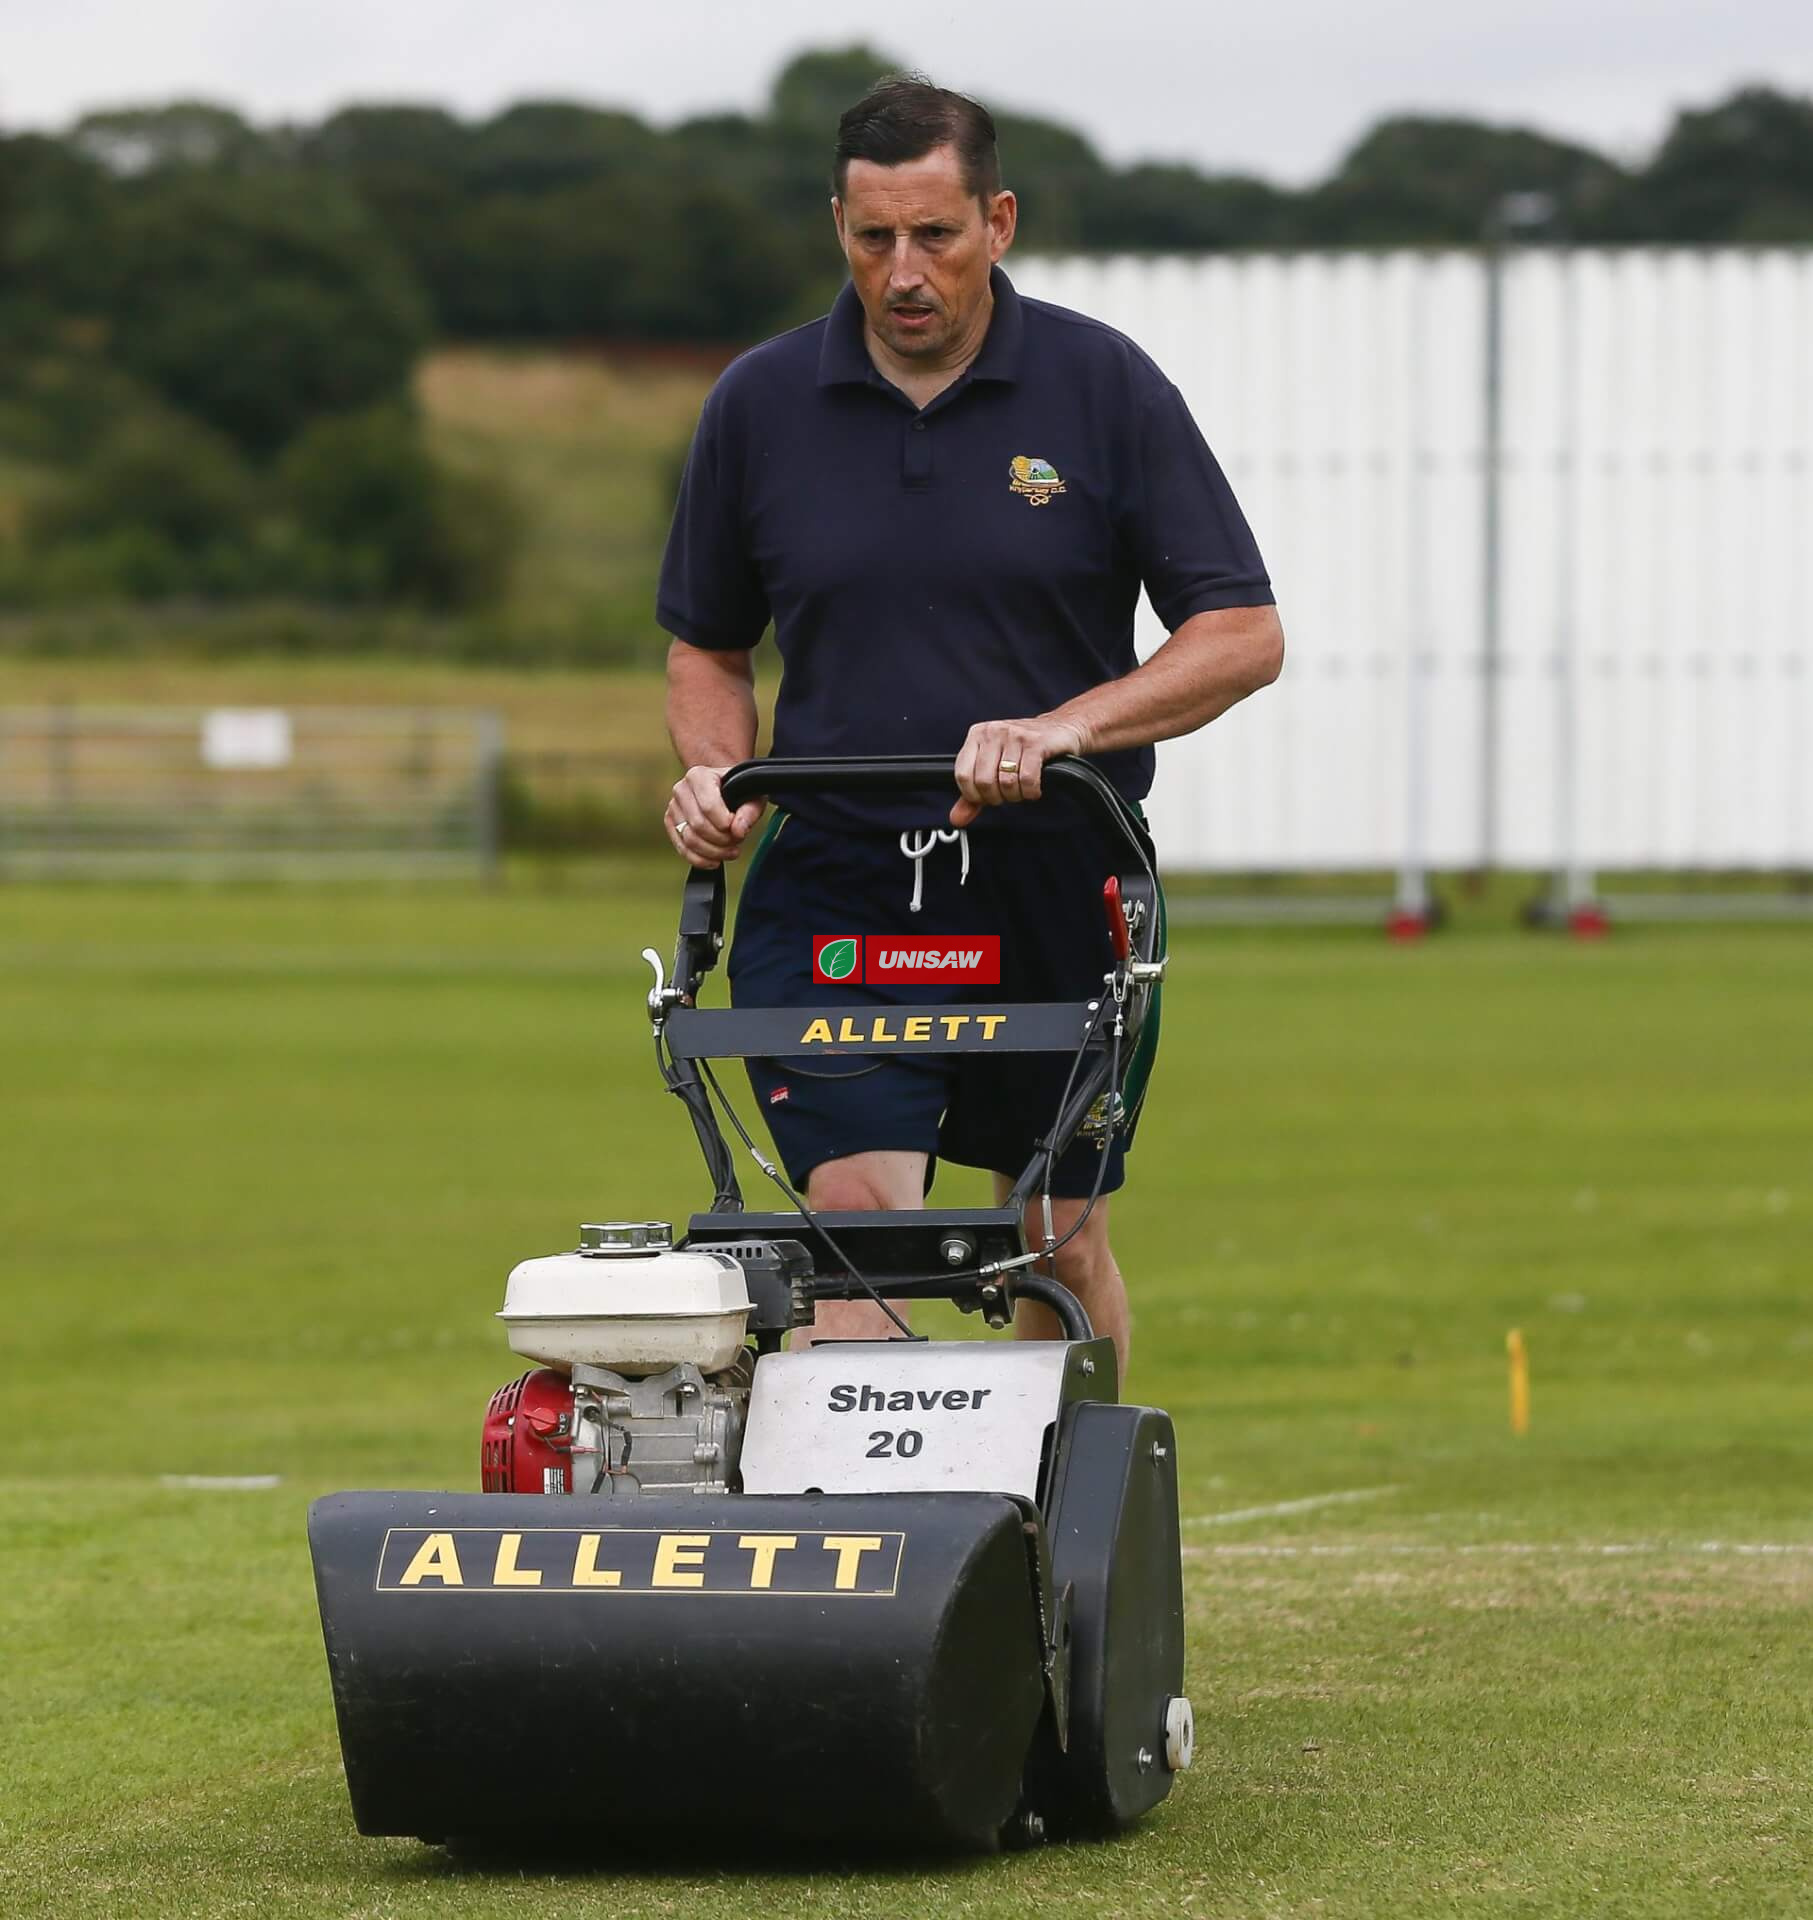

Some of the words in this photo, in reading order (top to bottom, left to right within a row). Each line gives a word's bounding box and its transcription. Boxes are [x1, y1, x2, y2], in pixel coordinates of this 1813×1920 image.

[800, 1015, 1007, 1043] ALLETT
[828, 1384, 991, 1412] Shaver
[865, 1430, 923, 1458] 20
[399, 1533, 882, 1589] ALLETT
